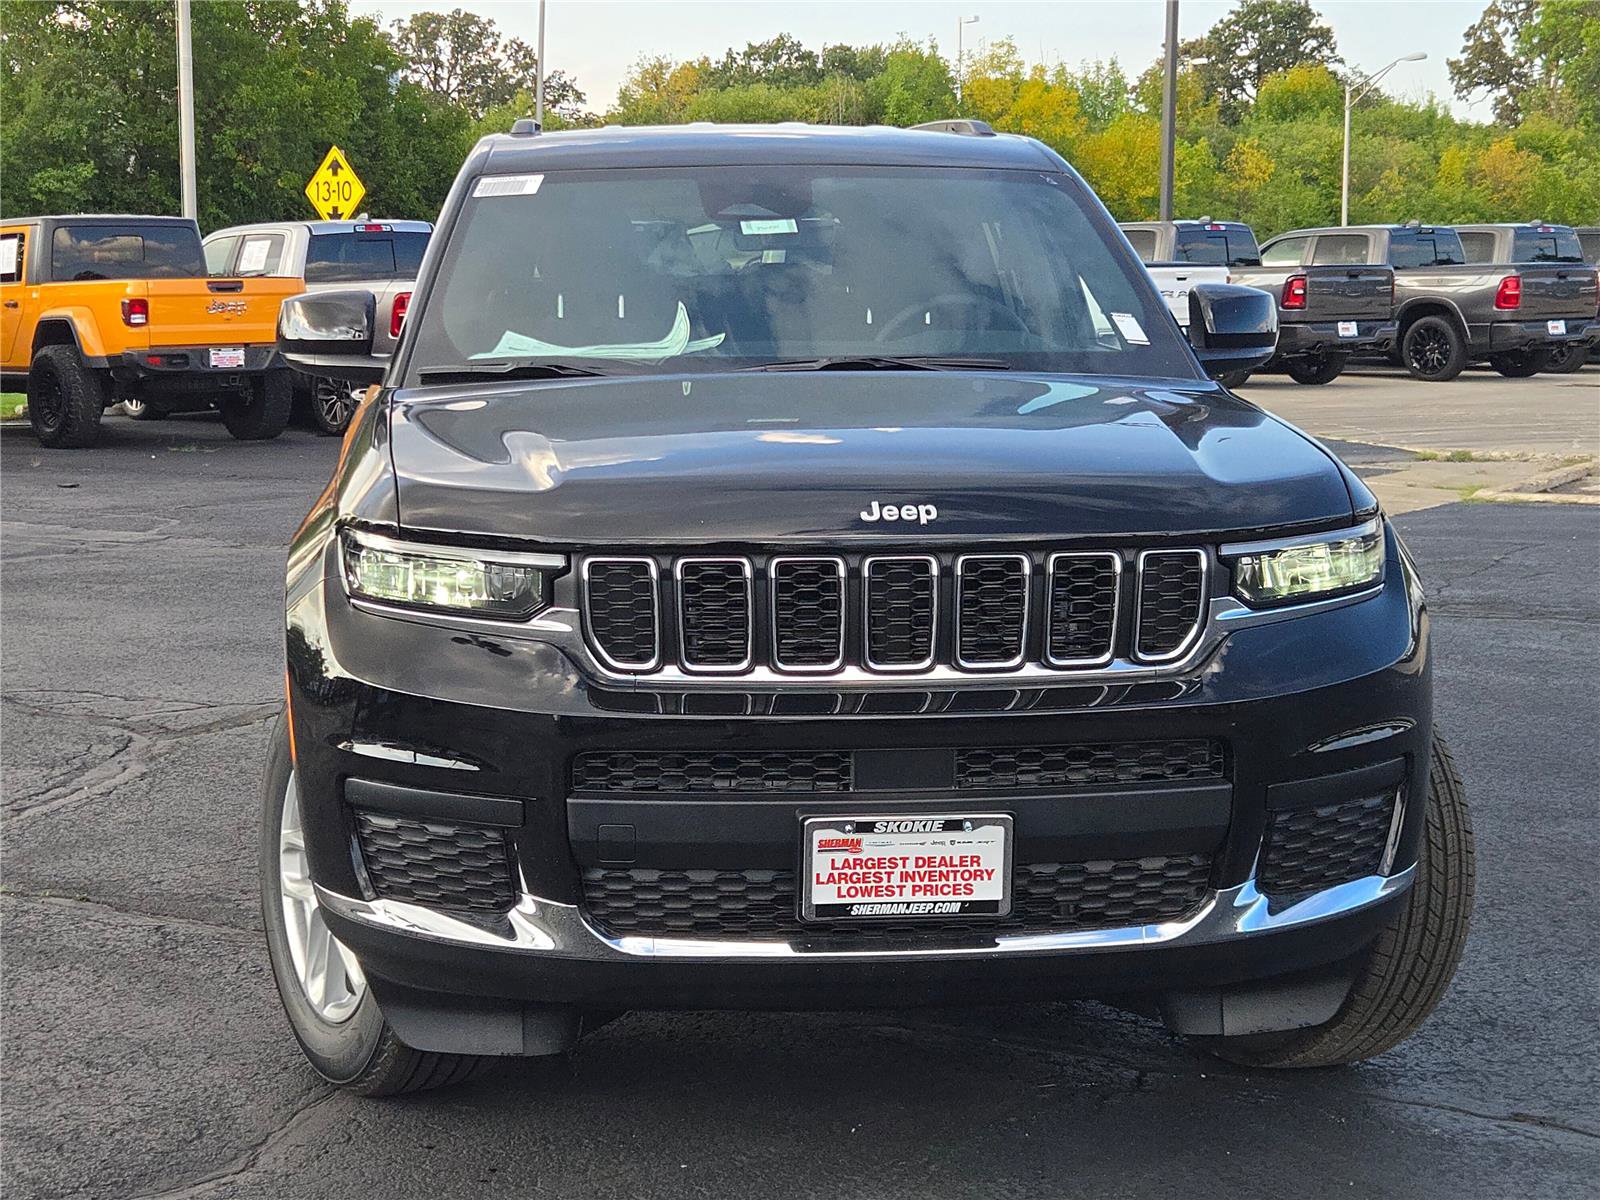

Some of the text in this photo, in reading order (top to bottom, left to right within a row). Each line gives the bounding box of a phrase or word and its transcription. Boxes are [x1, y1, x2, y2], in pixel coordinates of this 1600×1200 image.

[316, 181, 352, 202] 13-10
[207, 300, 247, 316] Jeep
[860, 501, 938, 525] Jeep
[873, 820, 945, 833] SKOKIE
[817, 837, 862, 848] SHERMAN
[830, 855, 981, 870] LARGEST DEALER
[815, 869, 995, 885] LARGEST INVENTORY
[836, 883, 974, 898] LOWEST PRICES
[850, 902, 961, 916] SHERMANJEEP.COM
